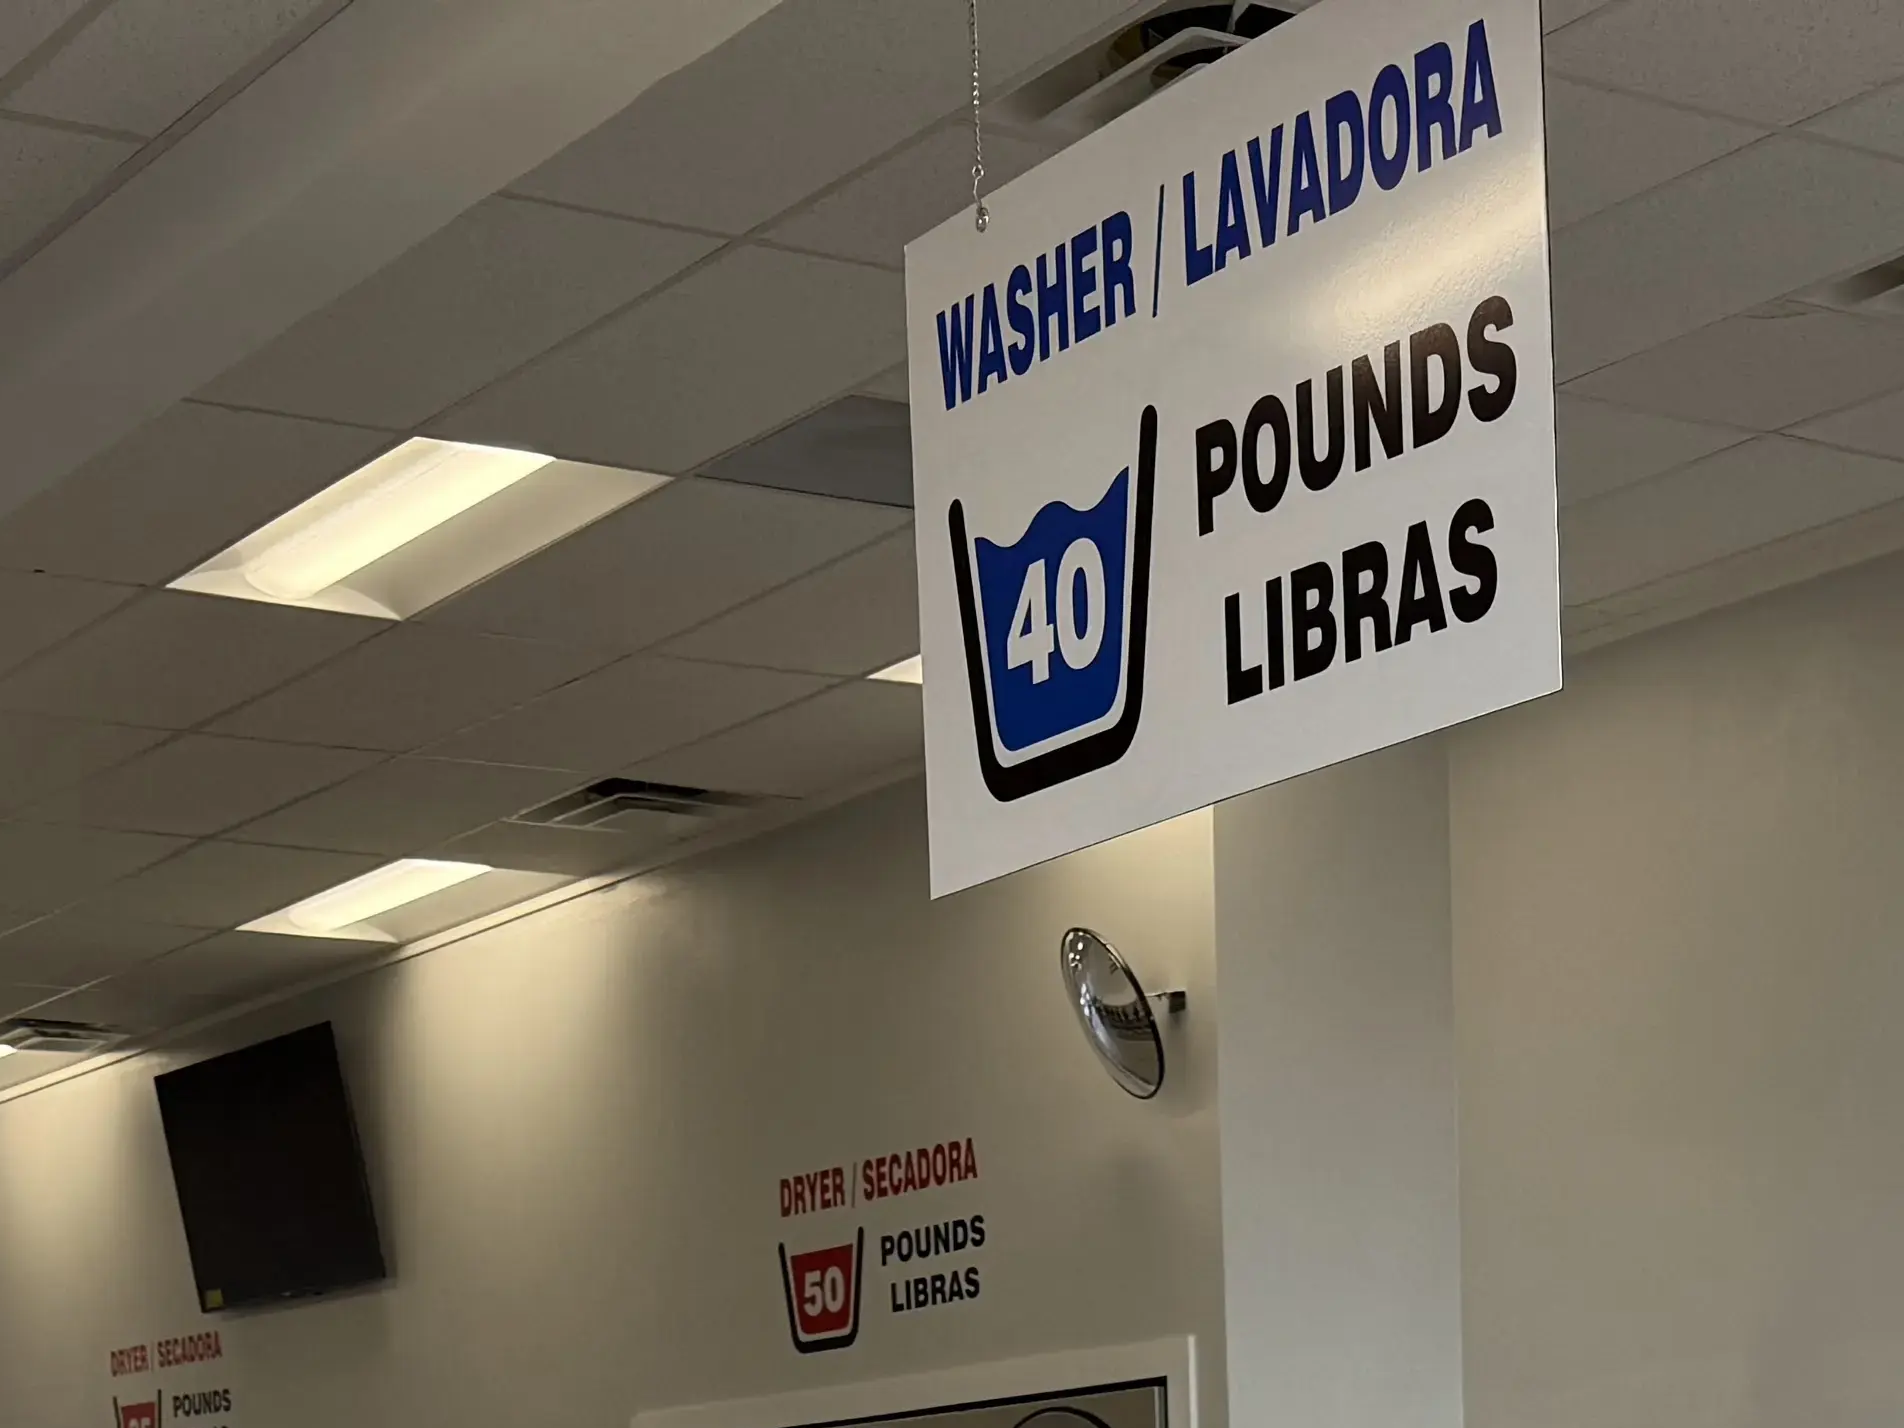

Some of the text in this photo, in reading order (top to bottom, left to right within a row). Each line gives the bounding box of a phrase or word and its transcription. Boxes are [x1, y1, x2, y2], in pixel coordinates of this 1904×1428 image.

[936, 208, 1137, 411] WASHER
[1184, 18, 1502, 286] LAVADORA
[1194, 295, 1518, 537] POUNDS
[1007, 536, 1106, 686] 40
[1225, 498, 1498, 705] LIBRAS
[779, 1167, 845, 1218] DRYER
[862, 1137, 978, 1201] SECADORA
[880, 1214, 985, 1266] POUNDS
[803, 1265, 845, 1317] 50
[891, 1266, 980, 1313] LIBRAS
[110, 1344, 149, 1377] DRYER
[157, 1330, 223, 1368] SECADORA
[172, 1388, 232, 1418] POUNDS
